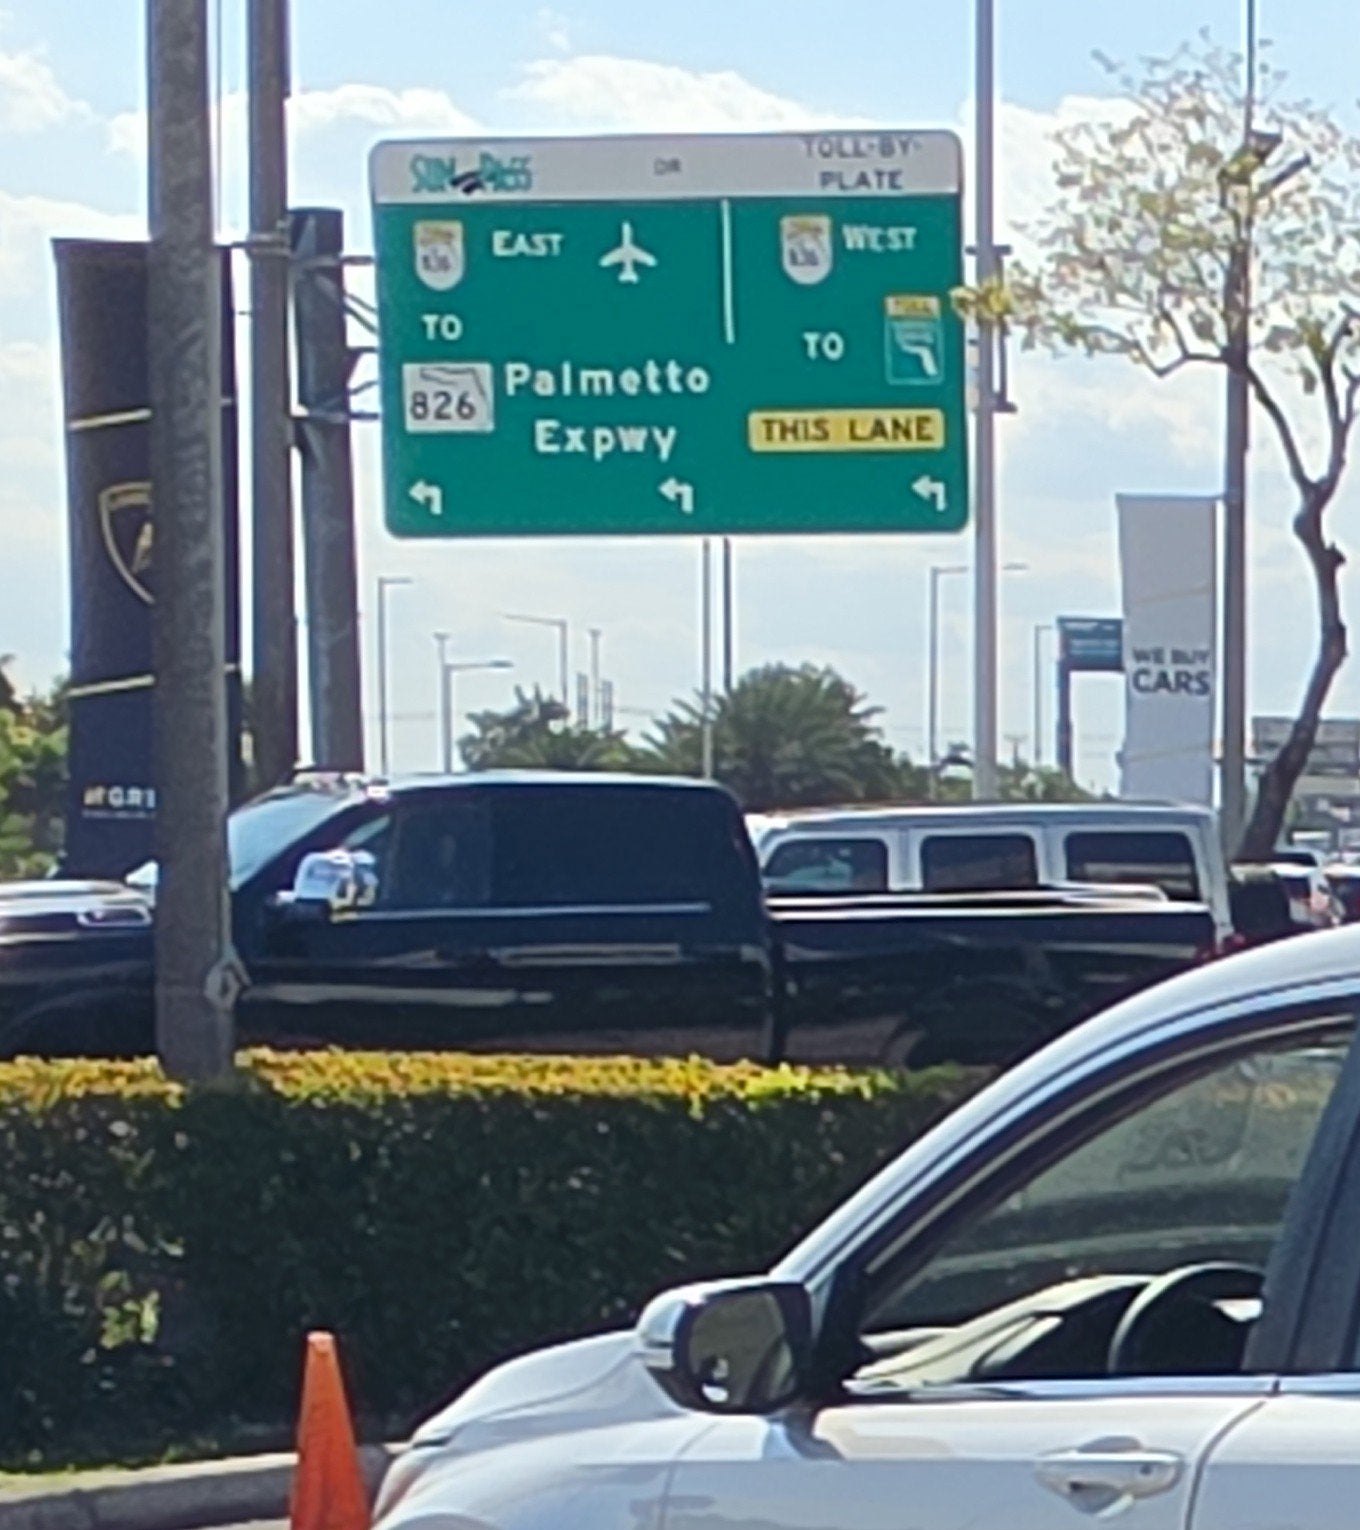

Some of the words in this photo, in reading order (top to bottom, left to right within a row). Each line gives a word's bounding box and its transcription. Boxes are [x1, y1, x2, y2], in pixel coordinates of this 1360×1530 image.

[818, 169, 903, 191] PLATE
[492, 229, 564, 257] EAST
[842, 224, 917, 253] WEST
[421, 313, 463, 341] TO
[803, 331, 844, 361] TO
[505, 359, 710, 397] Palmetto
[410, 390, 477, 421] 826
[534, 418, 677, 462] Expwy
[761, 418, 830, 443] THIS
[848, 415, 935, 443] LANE
[1132, 648, 1165, 665] WE
[1171, 648, 1211, 665] BUY
[1132, 668, 1211, 696] CARS
